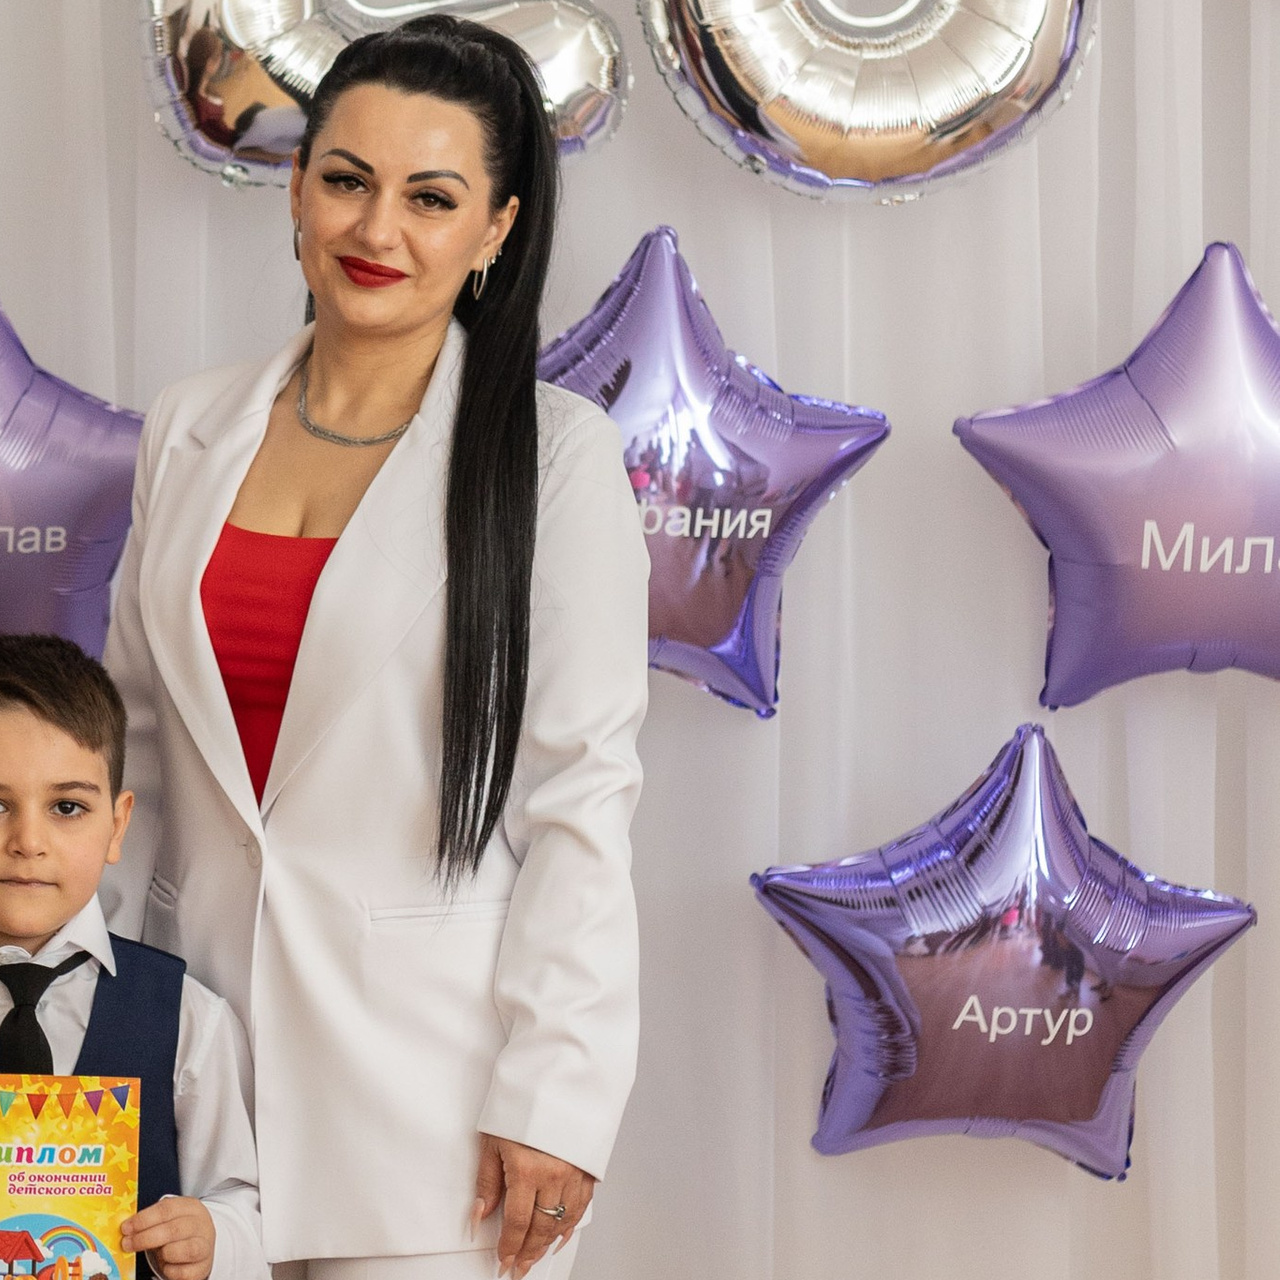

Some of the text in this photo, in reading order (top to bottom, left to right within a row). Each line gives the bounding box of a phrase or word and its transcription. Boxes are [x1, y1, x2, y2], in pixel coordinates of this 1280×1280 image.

[1141, 520, 1280, 574] Мил
[951, 994, 1094, 1046] Артур
[8, 1172, 106, 1183] об окончании
[8, 1183, 112, 1195] детского сада
